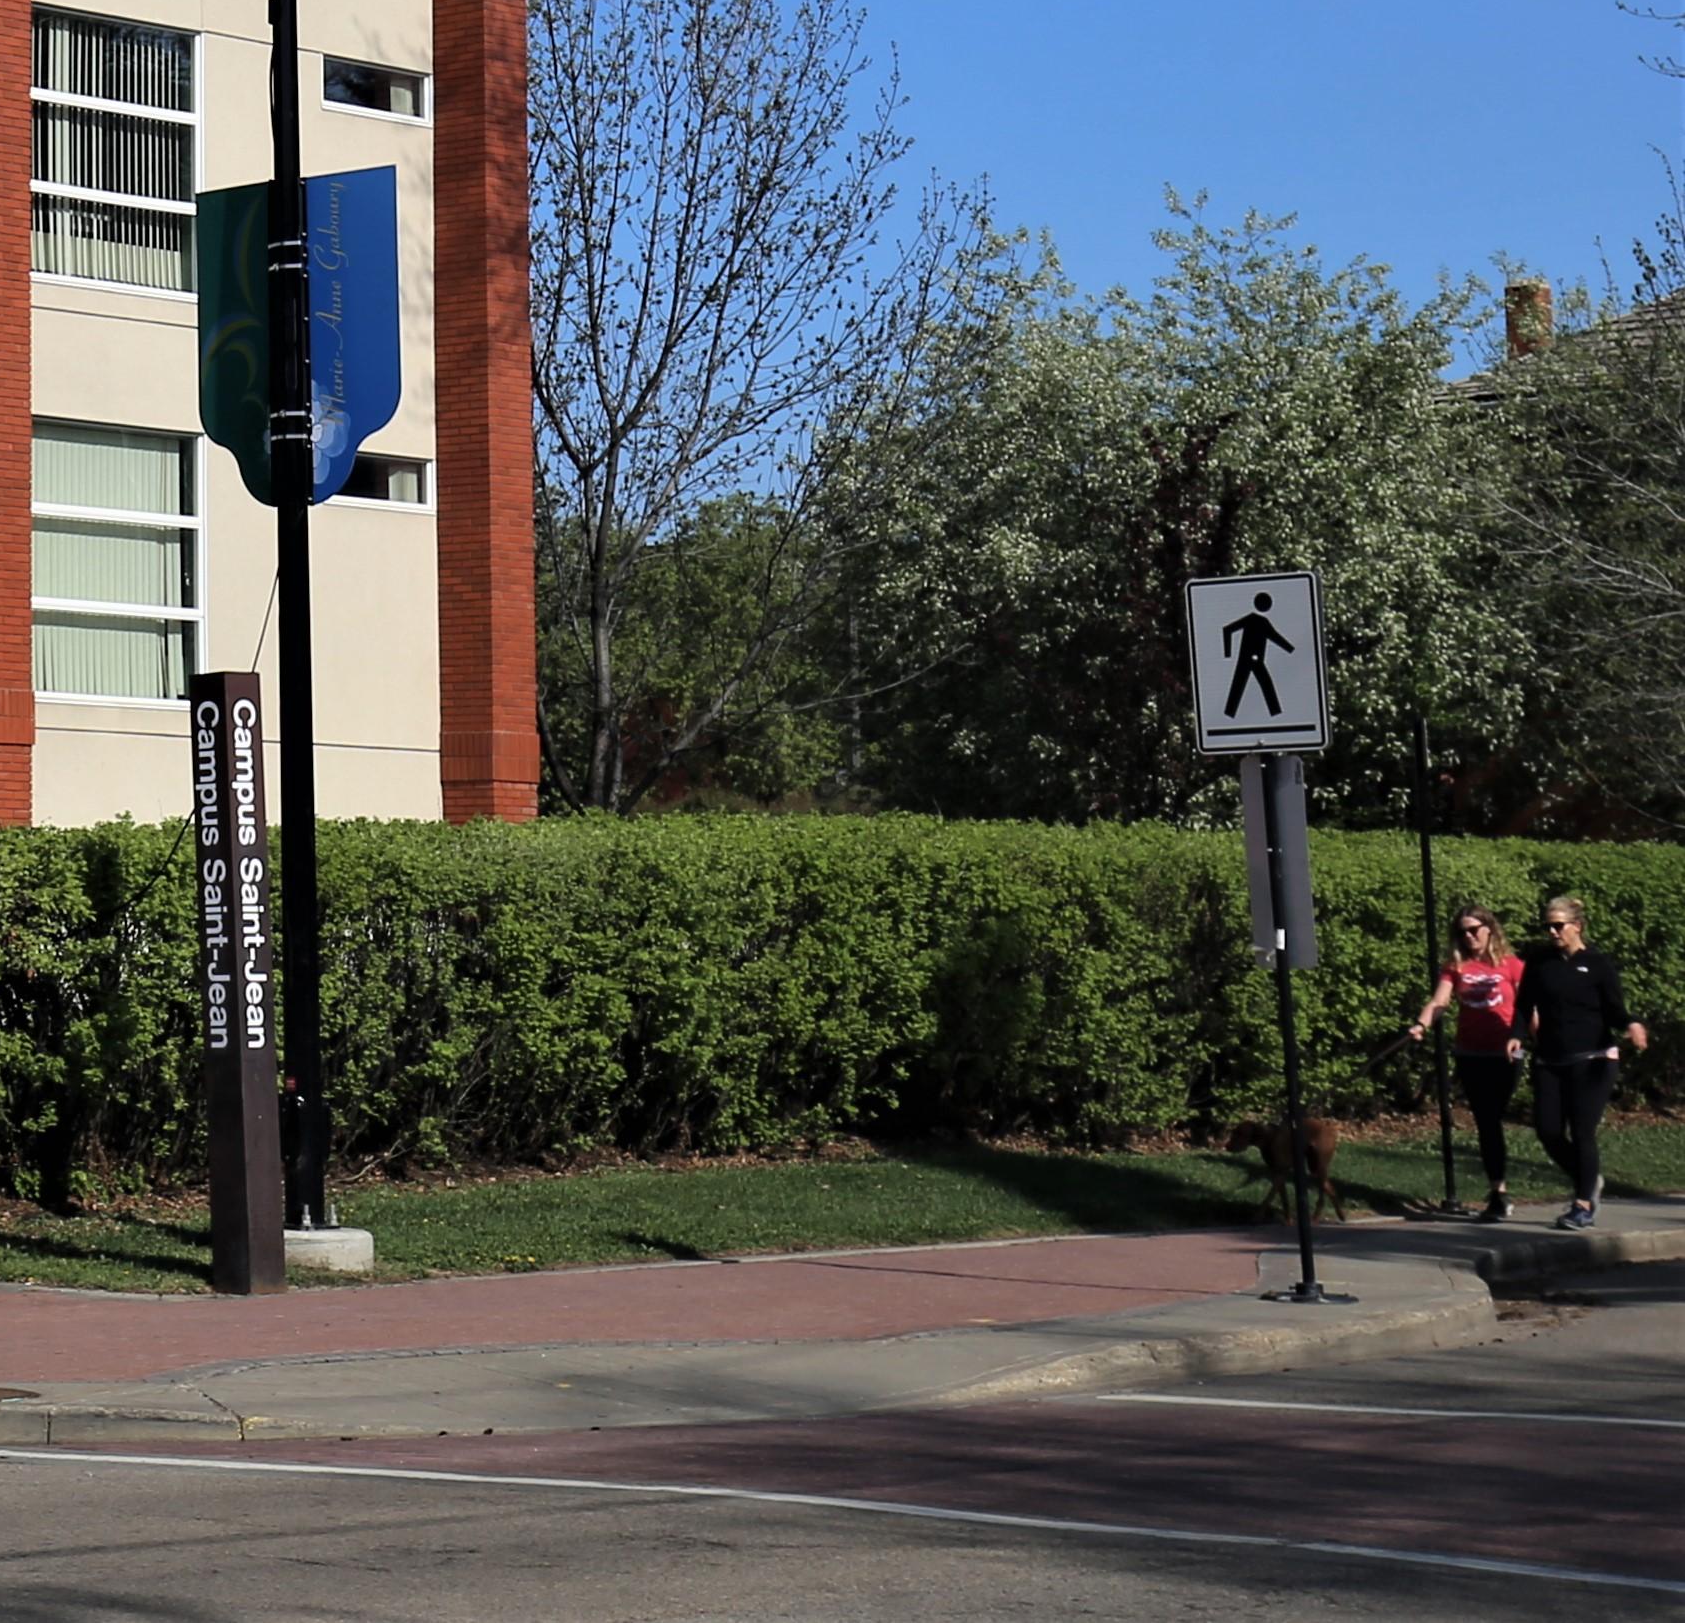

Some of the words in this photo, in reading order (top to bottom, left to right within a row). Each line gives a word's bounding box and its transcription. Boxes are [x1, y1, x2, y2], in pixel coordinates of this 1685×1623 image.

[314, 182, 349, 270] Gaboury
[315, 280, 346, 427] Marie-Anne
[195, 700, 219, 846] Campus
[232, 699, 257, 846] Campus
[203, 858, 230, 1049] Saint-Jean
[240, 856, 267, 1049] Saint-Jean
